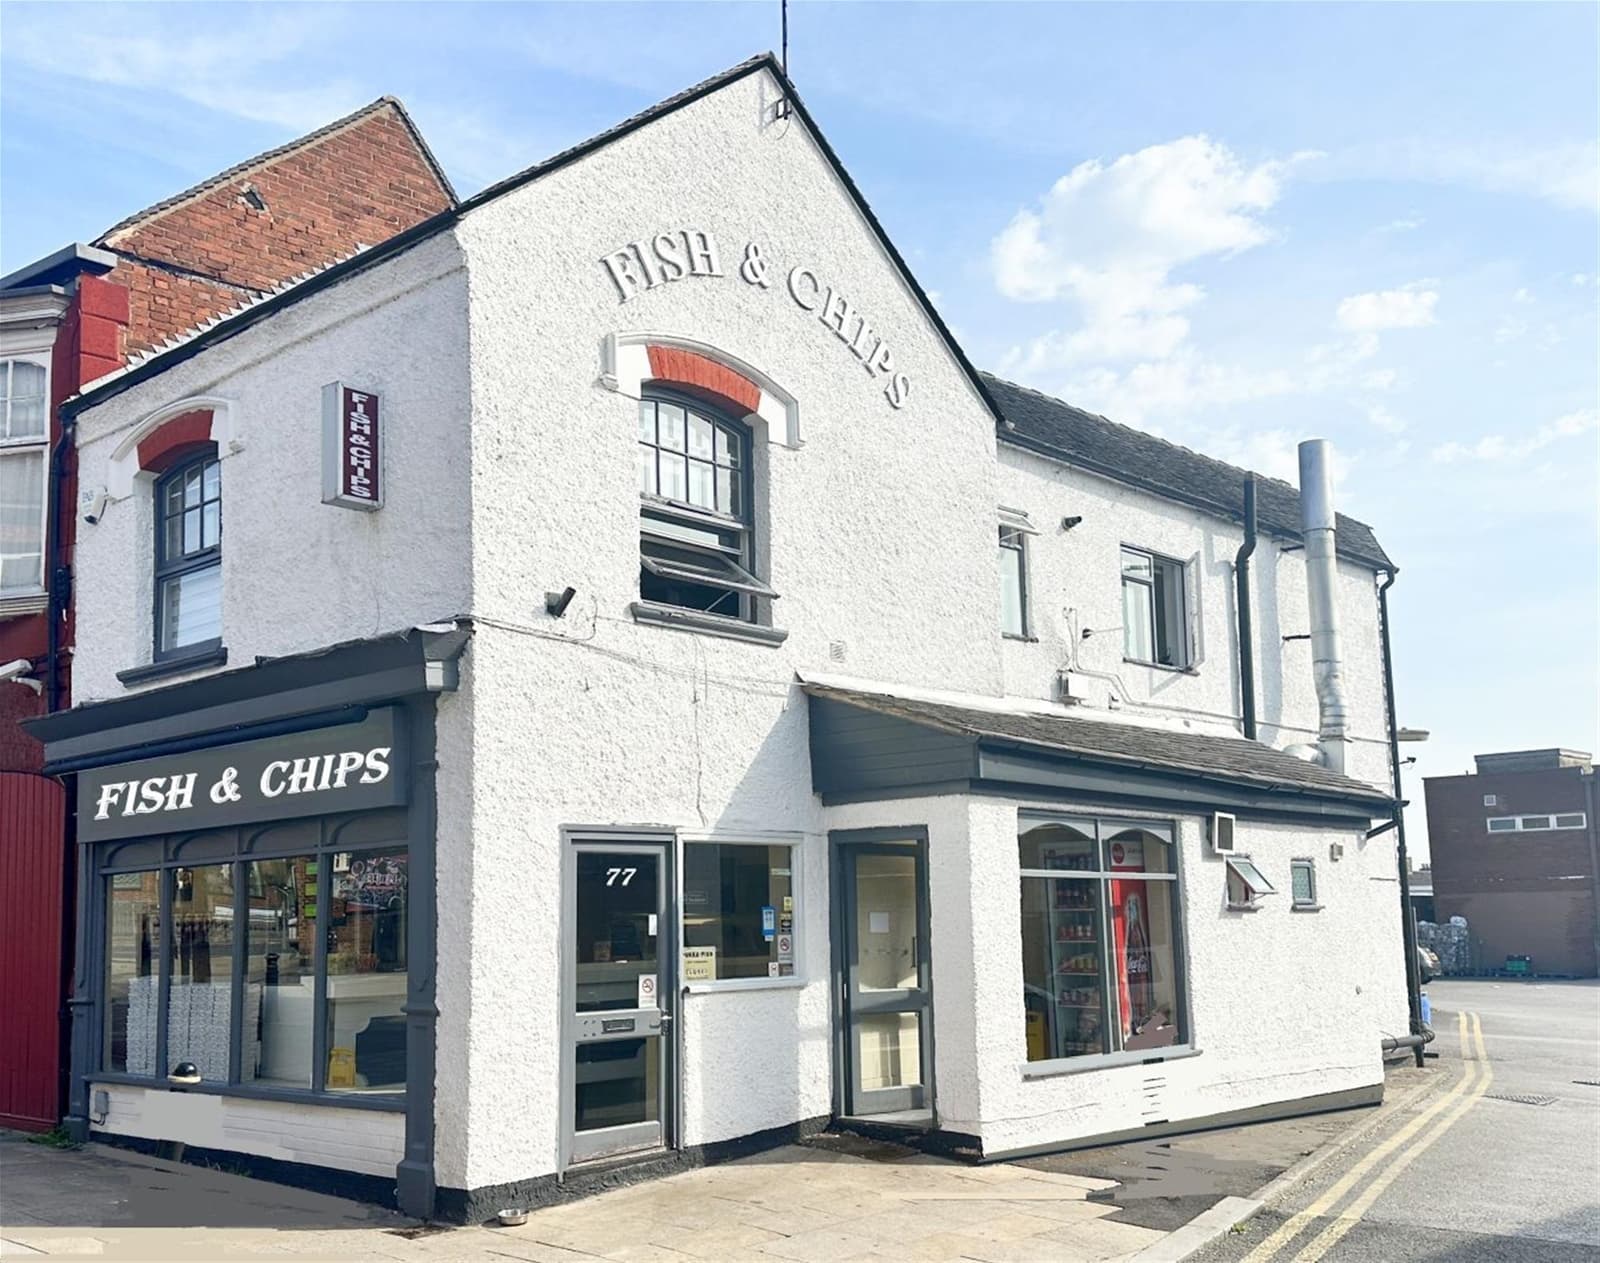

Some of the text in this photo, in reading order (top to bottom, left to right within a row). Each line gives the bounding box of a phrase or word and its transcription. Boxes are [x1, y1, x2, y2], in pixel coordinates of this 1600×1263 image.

[599, 231, 911, 410] FISH & CHIPS
[94, 747, 392, 821] FISH & CHIPS
[606, 868, 637, 886] 77
